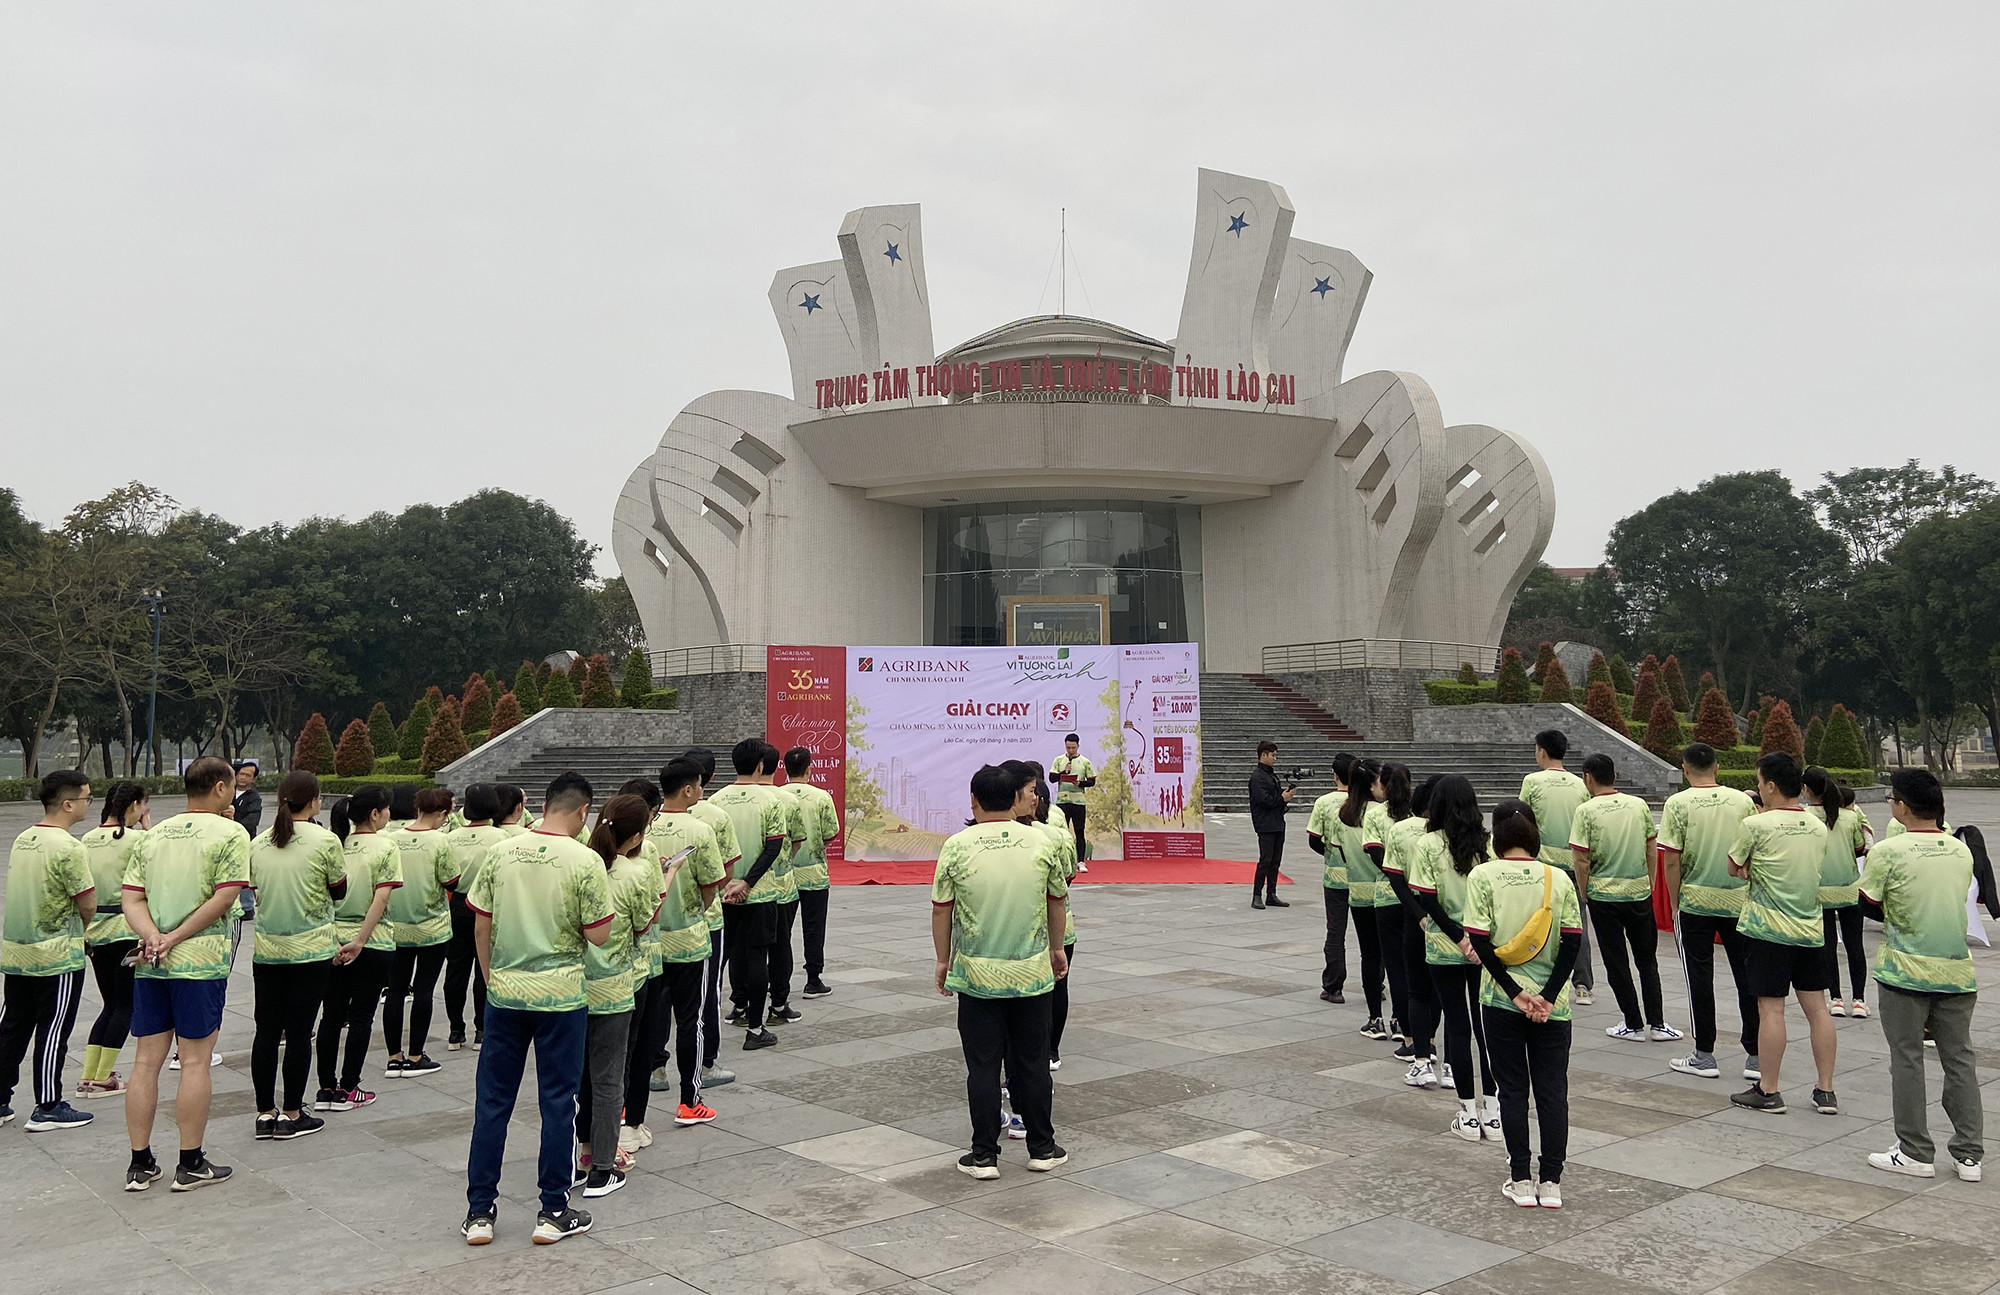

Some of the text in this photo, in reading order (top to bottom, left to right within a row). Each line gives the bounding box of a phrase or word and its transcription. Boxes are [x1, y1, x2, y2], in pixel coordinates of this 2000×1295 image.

[815, 343, 1296, 410] TRUNG TÂM THÔNG TIN VÀ TRIỂN LÃM TỈNH LÀO CAI
[879, 660, 971, 673] AGRIBANK
[1006, 660, 1073, 671] VÌ TƯƠNG LAI
[787, 669, 829, 690] 35 NĂM
[900, 675, 926, 683] NHÁNH
[927, 675, 943, 683] LÀO
[787, 693, 832, 701] AGRIBANK
[946, 698, 1031, 721] GIẢI CHẠY
[1171, 702, 1193, 713] 10.000
[780, 713, 807, 731] Chúc
[889, 721, 1031, 732] CHÀO MỪNG 35 NĂM NGÀY THÀNH LẬP
[1157, 745, 1170, 764] 35
[824, 757, 840, 770] LẬP
